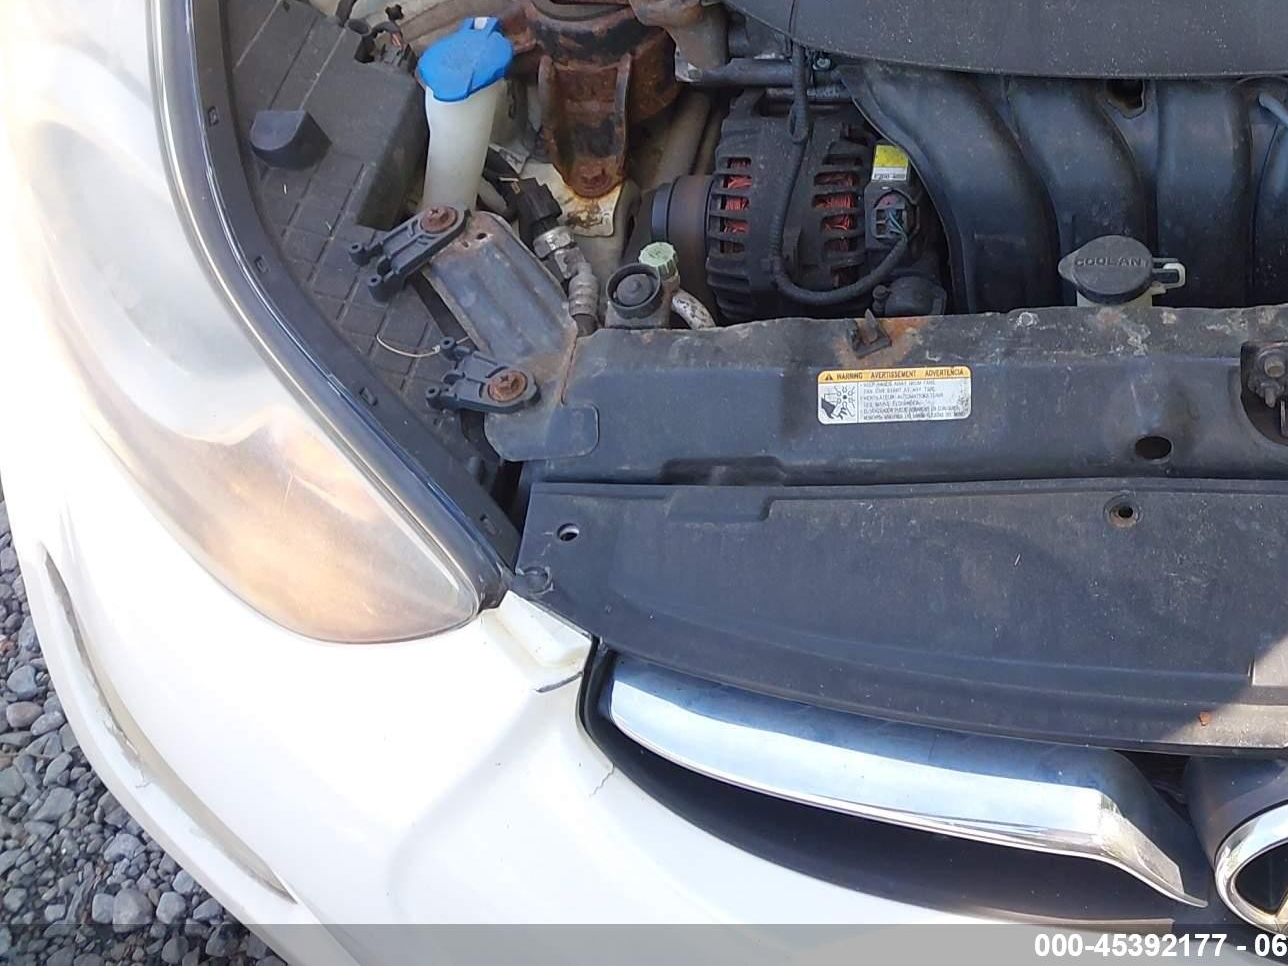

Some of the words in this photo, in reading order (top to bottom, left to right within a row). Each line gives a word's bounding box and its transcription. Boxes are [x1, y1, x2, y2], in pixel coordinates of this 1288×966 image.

[1074, 256, 1149, 267] COOLANT
[836, 372, 864, 380] WARNING
[870, 370, 917, 379] AVERTISSEMENT
[924, 369, 964, 377] ADVERTENCIA
